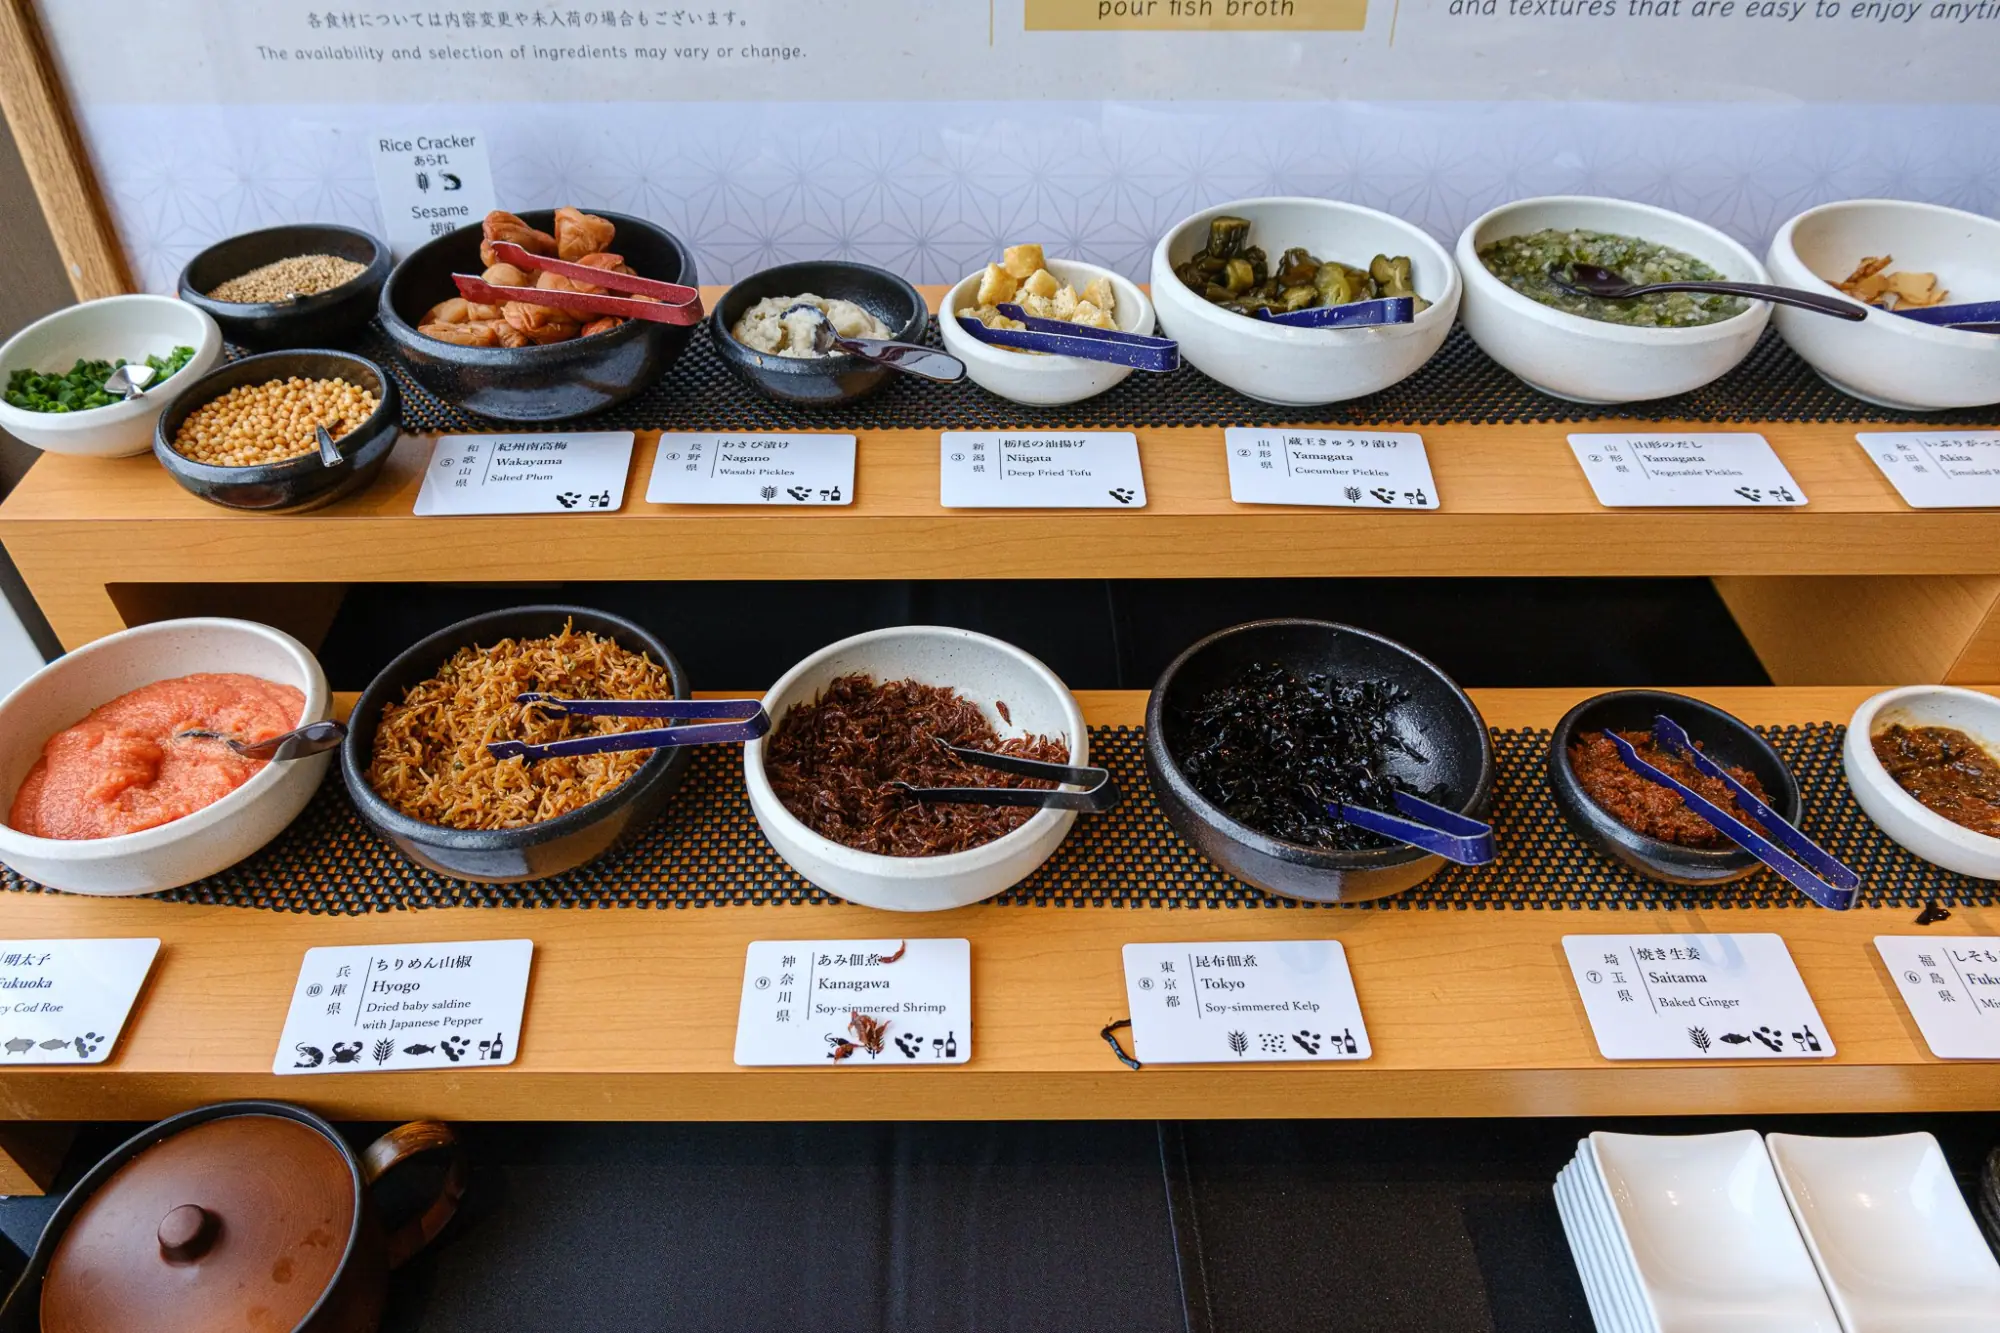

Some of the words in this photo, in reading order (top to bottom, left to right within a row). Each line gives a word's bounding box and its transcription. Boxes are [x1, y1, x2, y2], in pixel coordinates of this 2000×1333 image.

[1098, 0, 1158, 19] pour
[1226, 0, 1295, 17] broth
[1449, 0, 1497, 16] and
[1509, 0, 1616, 16] textures
[1628, 0, 1682, 16] that
[1691, 0, 1734, 17] are
[1745, 0, 1808, 22] easy
[1815, 0, 1840, 18] to
[1850, 0, 1922, 23] enjoy
[257, 45, 288, 60] The
[295, 45, 384, 63] availability
[391, 46, 421, 60] and
[429, 46, 504, 60] selection
[510, 45, 526, 60] of
[533, 45, 628, 62] ingredients
[634, 47, 667, 62] may
[674, 47, 710, 62] vary
[716, 47, 734, 60] or
[740, 45, 807, 62] change.
[379, 139, 413, 152] Rice
[416, 134, 476, 151] Cracker
[413, 154, 450, 167] あられ
[411, 205, 469, 219] Sesame
[497, 441, 568, 451] 紀州南高梅
[721, 440, 790, 450] わさび漬け
[1003, 439, 1086, 449] 栃尾の油揚げ
[1288, 436, 1399, 449] 蔵王きゅうり漬け
[1633, 440, 1703, 449] 山形のだし
[686, 443, 703, 472] 長野県
[721, 454, 771, 463] Nagano
[972, 442, 986, 474] 新潟県
[1006, 453, 1053, 464] Niigata
[1257, 439, 1273, 470] 山形県
[1292, 451, 1354, 462] Yamagata
[1603, 443, 1630, 474] 山形県
[1643, 454, 1706, 464] Yamagata
[1895, 443, 1929, 473] 秋田県
[1939, 453, 1973, 461] Akita
[454, 443, 480, 488] 和歌山県
[496, 457, 563, 468] Wakayama
[489, 474, 523, 482] Salted
[525, 473, 554, 481] Plum
[719, 468, 756, 476] Wasabi
[759, 468, 795, 476] Pickles
[1007, 469, 1035, 479] Deep
[1037, 468, 1065, 477] Fried
[1067, 468, 1092, 477] Tofu
[1294, 466, 1350, 476] Cucumber
[1352, 468, 1390, 477] Pickles
[1651, 468, 1702, 478] Vegetable
[1705, 468, 1743, 477] Pickles
[4, 953, 52, 967] 明太子
[817, 952, 881, 968] あみ佃煮
[1636, 946, 1701, 961] 焼き生姜
[1952, 949, 2000, 963] しそも
[375, 954, 473, 972] ちりめん山椒
[1195, 954, 1258, 969] 昆布佃煮
[818, 977, 890, 992] Kanagawa
[1159, 960, 1181, 1008] 東京都
[1603, 953, 1634, 1003] 埼玉県
[1648, 971, 1708, 984] Saitama
[1918, 953, 1956, 1003] 福島県
[326, 965, 352, 1016] 兵庫県
[371, 979, 421, 995] Hyogo
[776, 954, 797, 1023] 神奈川県
[1200, 977, 1246, 993] Tokyo
[14, 1002, 40, 1013] Cod
[40, 1002, 64, 1013] Roe
[366, 1002, 400, 1013] Dried
[402, 1001, 430, 1014] baby
[431, 999, 472, 1011] saldine
[815, 1002, 900, 1015] Soy-simmered
[903, 1001, 947, 1015] Shrimp
[1205, 1002, 1290, 1015] Soy-simmered
[1292, 1001, 1321, 1014] Kelp
[1658, 996, 1696, 1008] Baked
[1698, 996, 1740, 1010] Ginger
[362, 1019, 387, 1030] with
[389, 1017, 440, 1031] Japanese
[443, 1016, 484, 1028] Pepper
